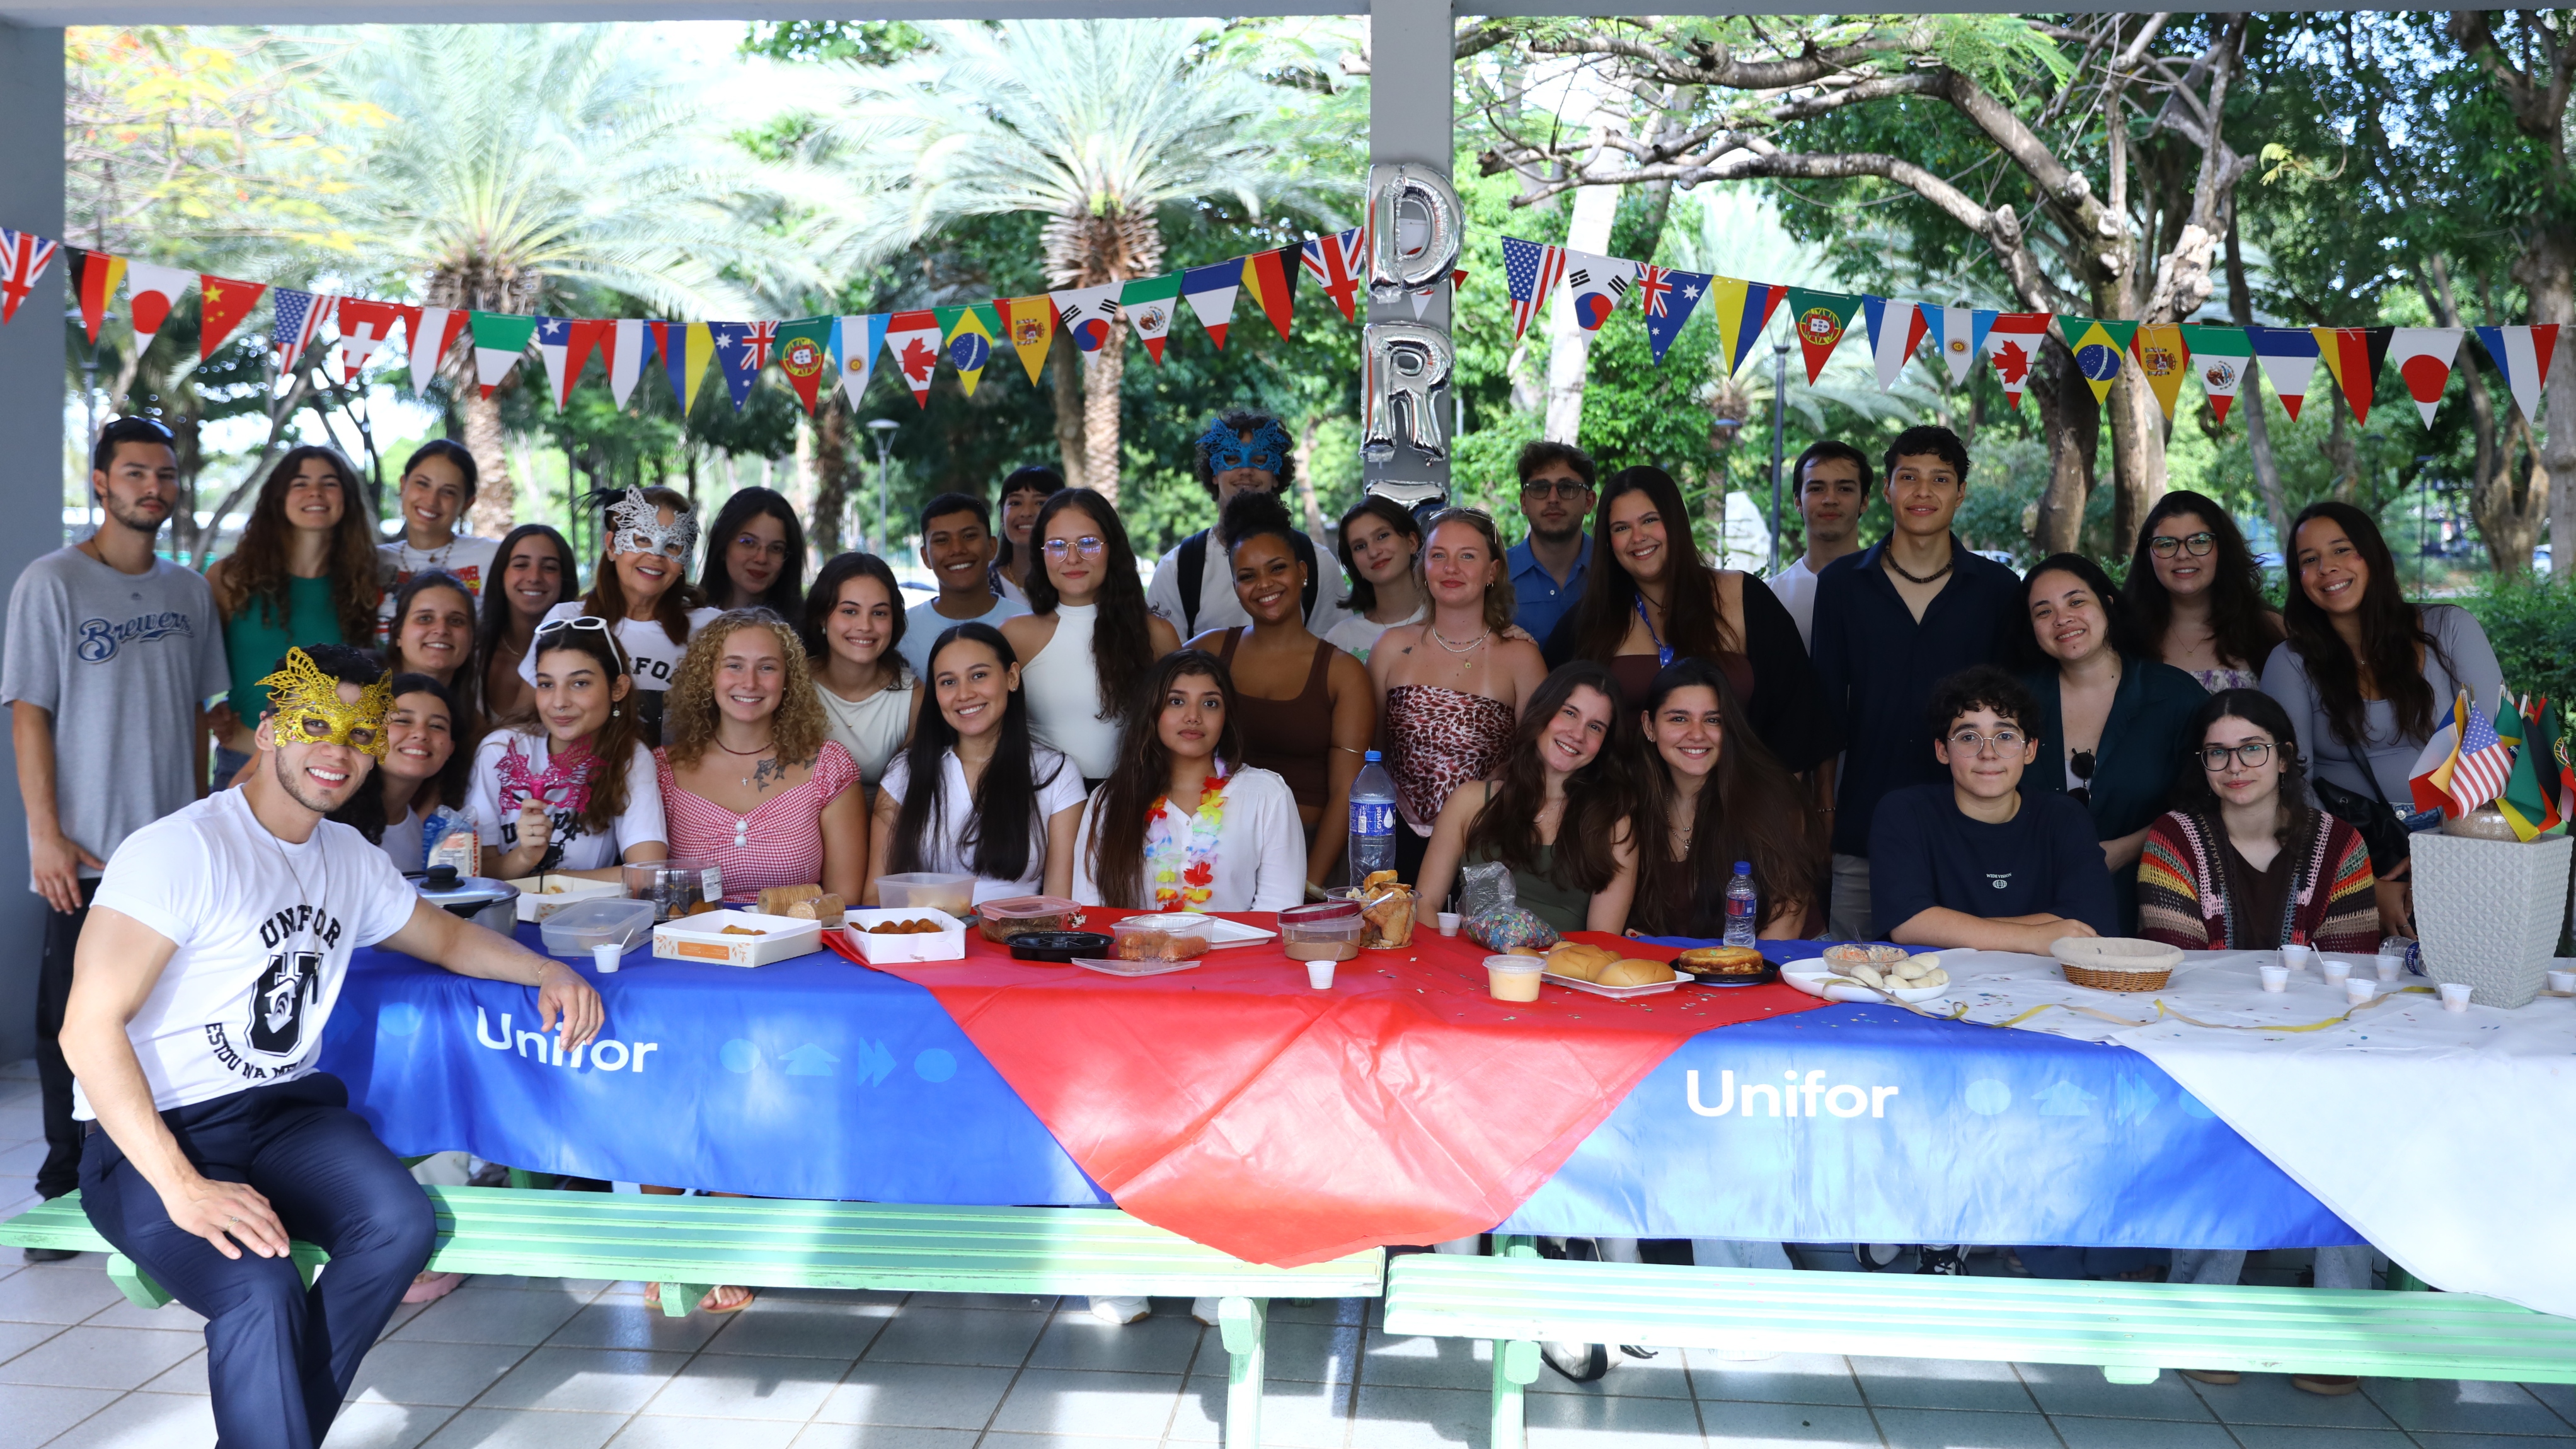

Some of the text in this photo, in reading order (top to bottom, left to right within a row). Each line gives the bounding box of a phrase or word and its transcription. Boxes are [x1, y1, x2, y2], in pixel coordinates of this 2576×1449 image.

[78, 611, 192, 662] Brewers
[260, 904, 341, 950] UNFOR
[205, 1022, 241, 1071] ESTOU
[242, 1062, 267, 1079] NA
[1687, 1070, 1899, 1118] Unifor
